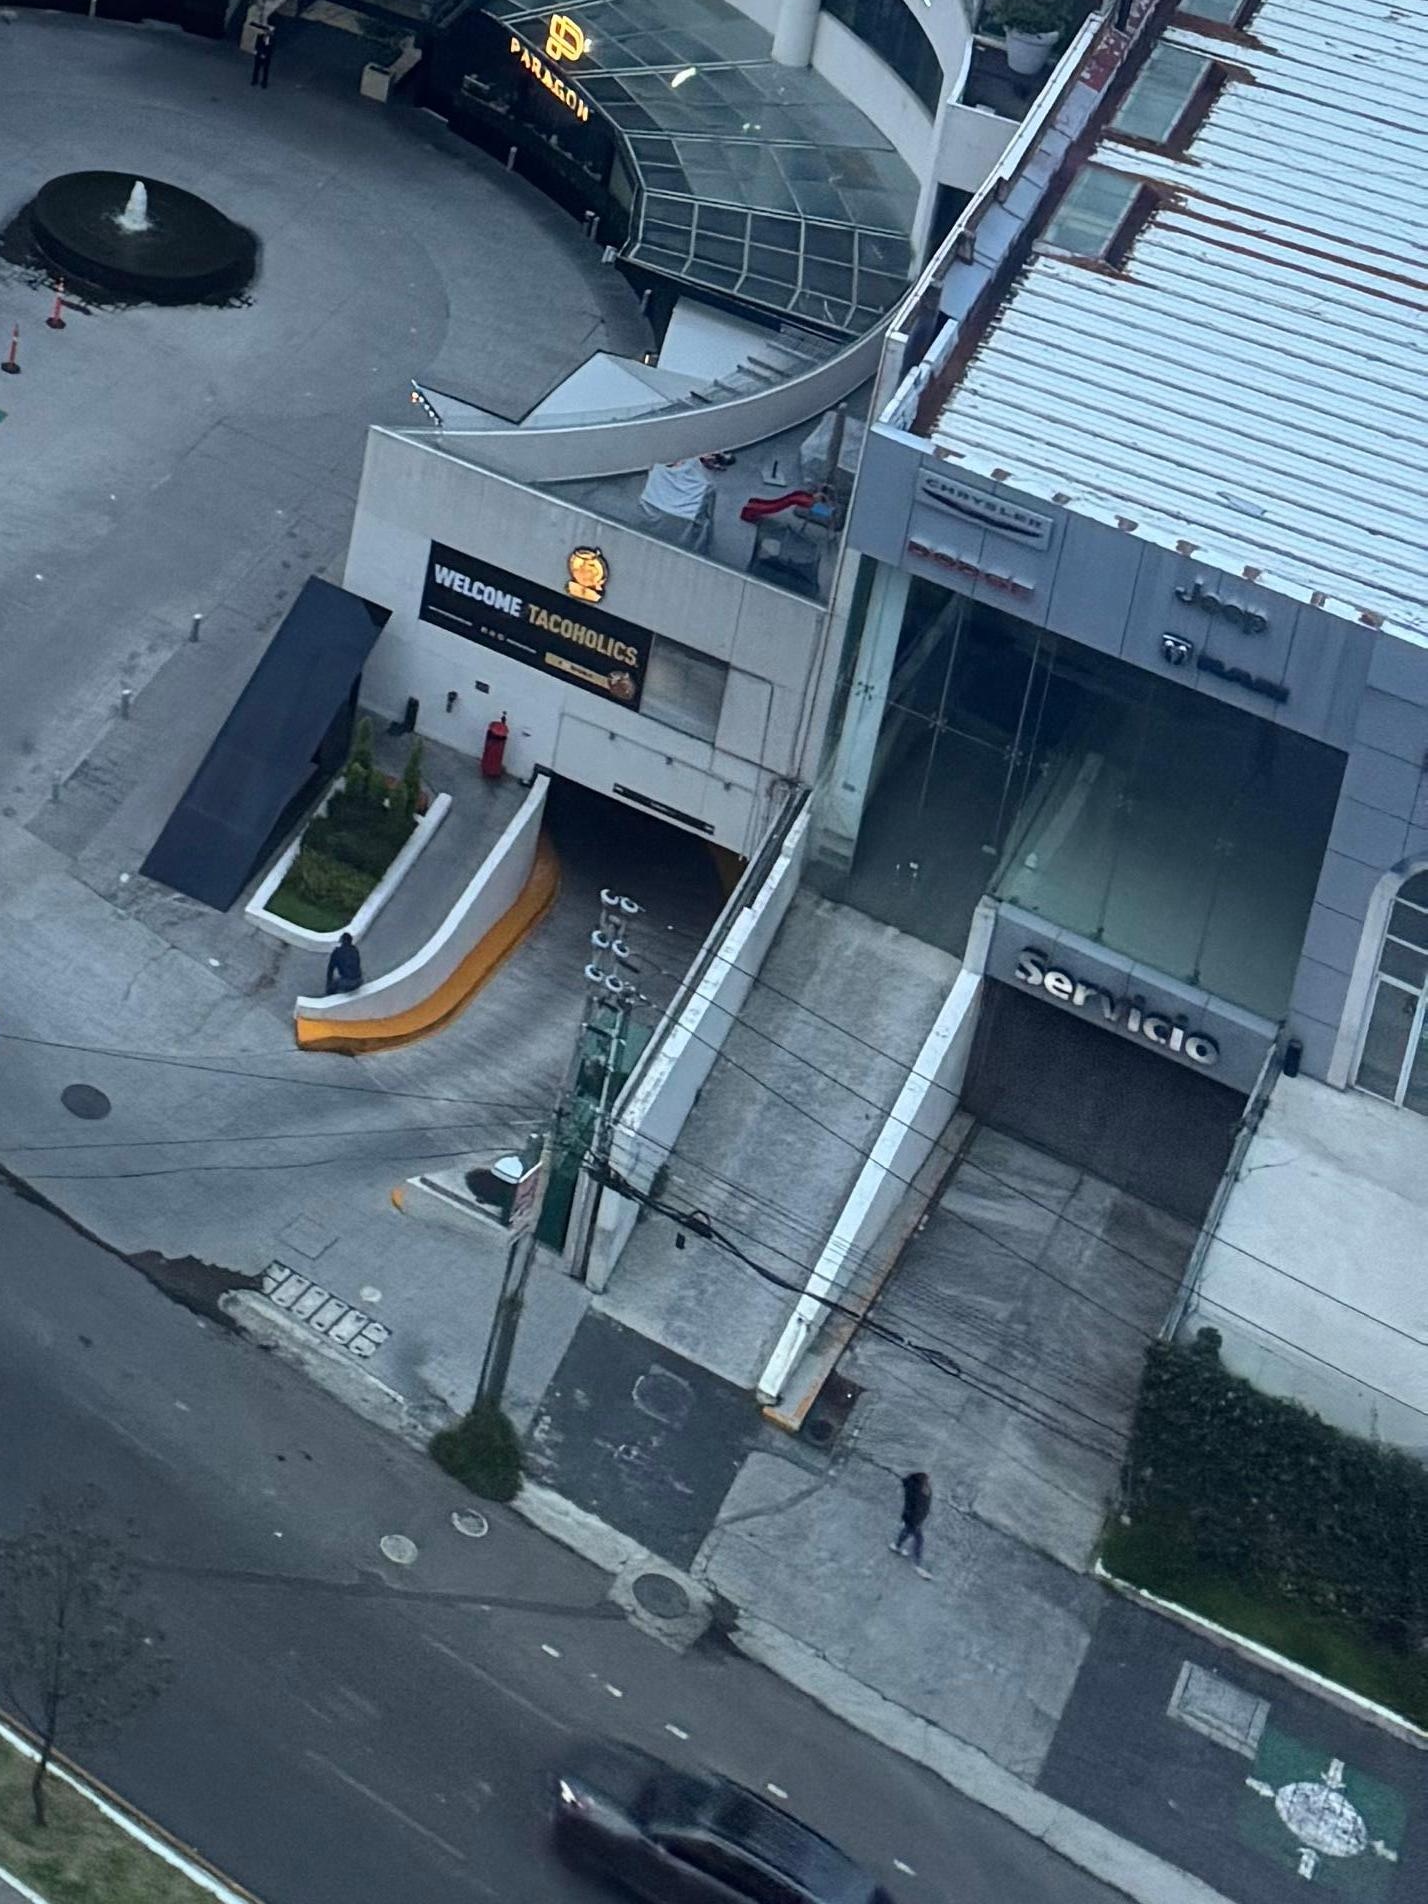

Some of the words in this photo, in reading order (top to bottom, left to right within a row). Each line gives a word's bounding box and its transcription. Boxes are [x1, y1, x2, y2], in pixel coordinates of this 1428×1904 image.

[510, 37, 588, 122] PARAGON
[925, 478, 1042, 529] CHRYSLER
[434, 563, 523, 618] WELCOME
[1014, 946, 1220, 1066] Servicio
